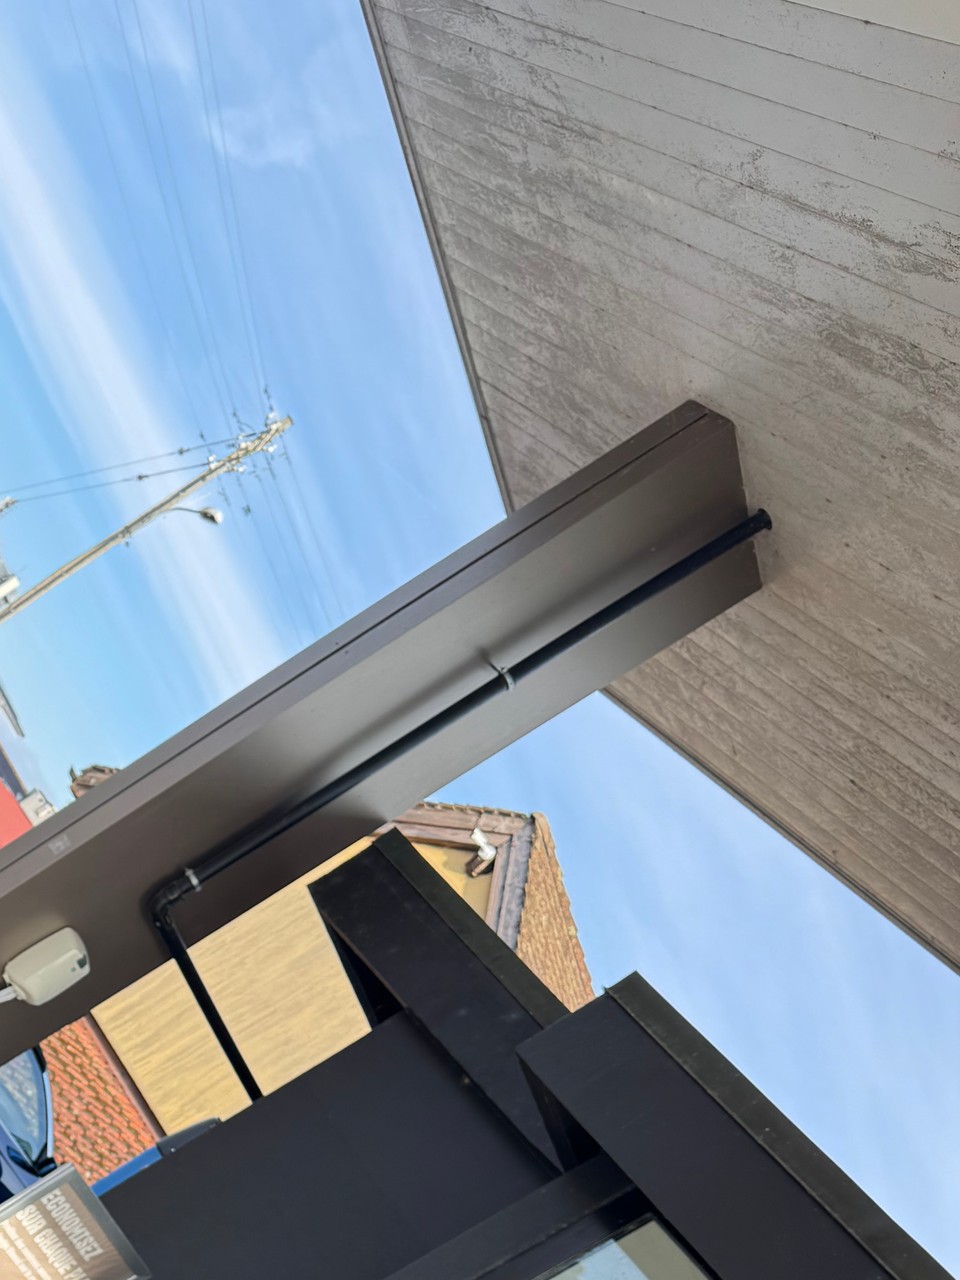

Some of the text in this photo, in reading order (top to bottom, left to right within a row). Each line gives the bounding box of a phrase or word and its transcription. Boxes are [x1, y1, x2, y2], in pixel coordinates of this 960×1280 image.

[15, 1204, 46, 1234] SUR
[33, 1227, 76, 1275] CHAQUE
[40, 1187, 104, 1263] ECONOMISEZ
